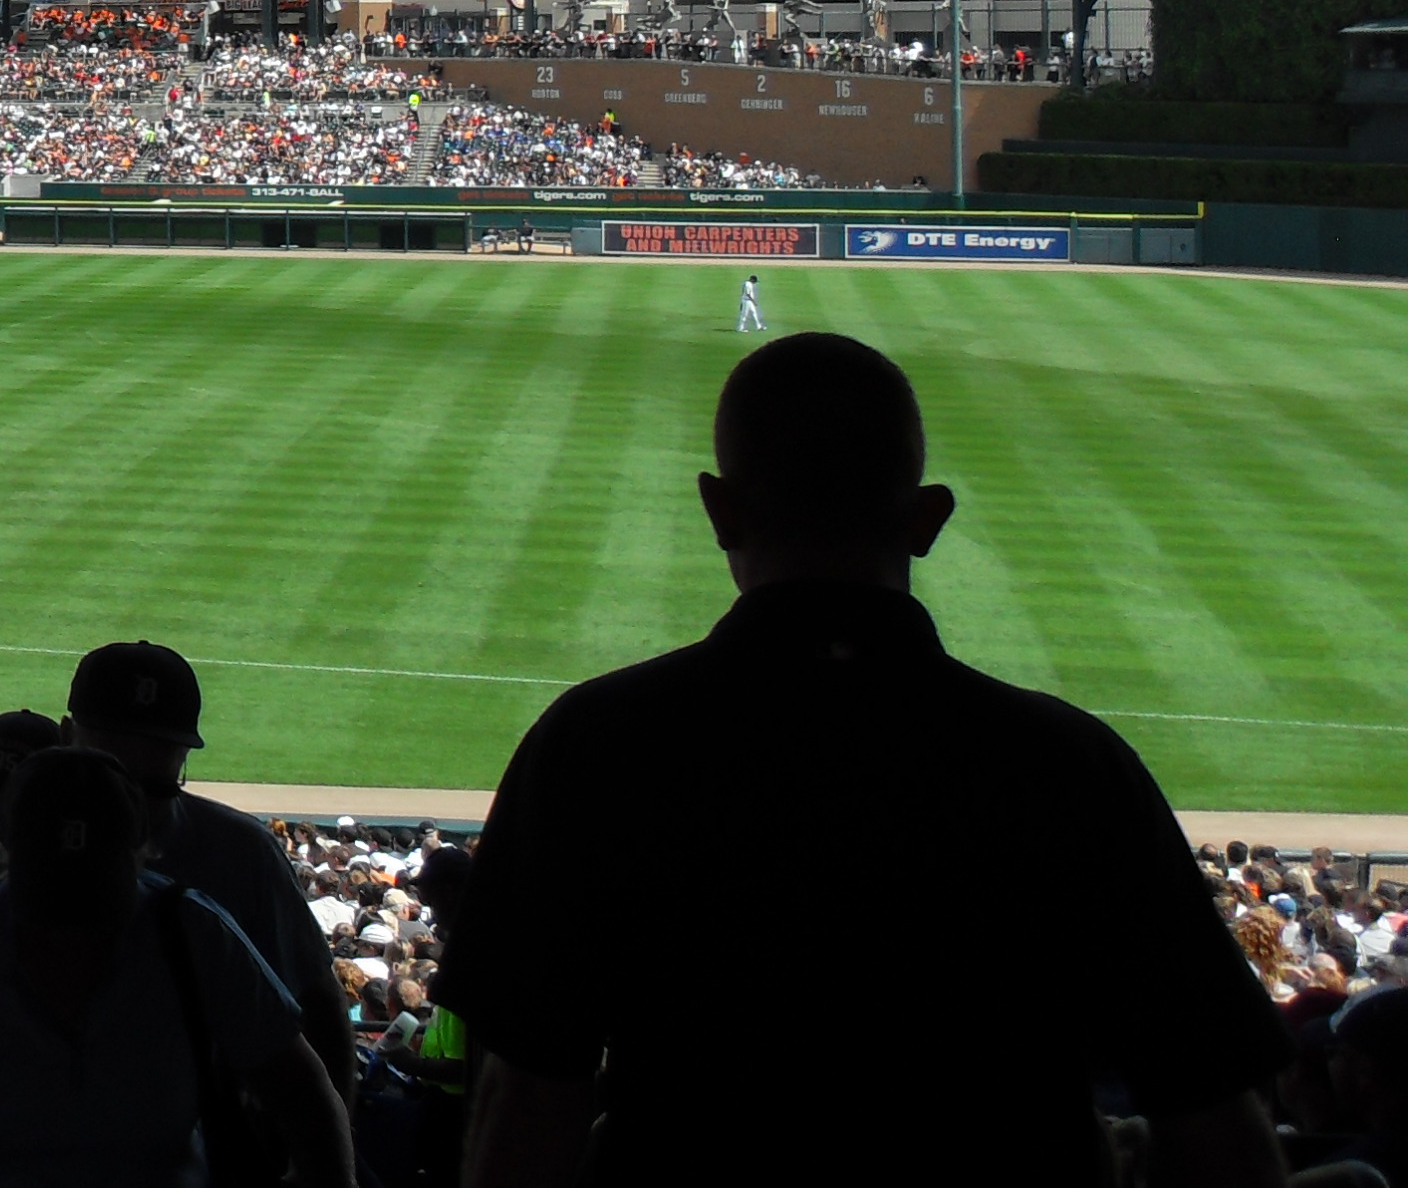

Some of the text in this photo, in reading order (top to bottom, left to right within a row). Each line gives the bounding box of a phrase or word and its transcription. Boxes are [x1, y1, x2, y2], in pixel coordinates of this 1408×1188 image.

[537, 66, 934, 105] 23 5 2 16 6
[534, 190, 606, 202] tigers.com
[689, 192, 764, 203] tigers.com
[621, 225, 799, 242] UNION CARPENTERS
[907, 232, 1052, 250] DTE Energy
[626, 240, 661, 253] AND
